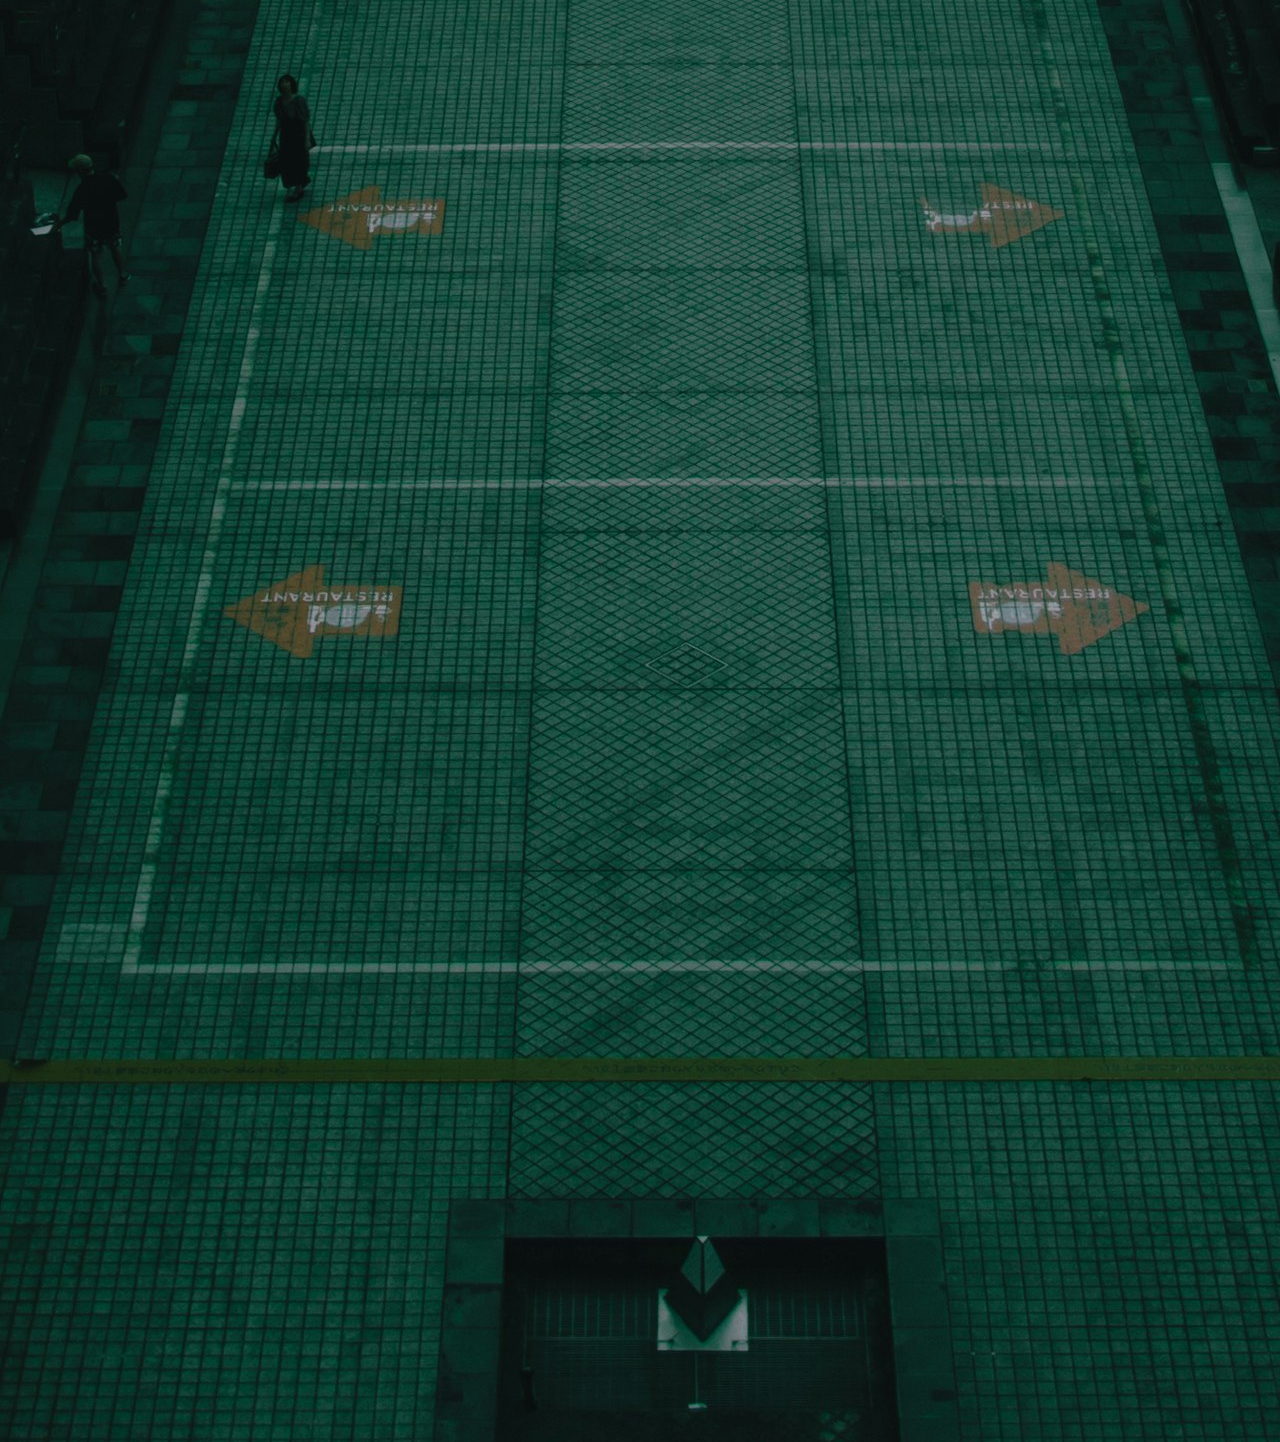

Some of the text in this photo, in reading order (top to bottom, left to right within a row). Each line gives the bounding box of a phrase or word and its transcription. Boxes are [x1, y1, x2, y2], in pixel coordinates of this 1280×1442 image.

[327, 202, 439, 212] RESTAURANT
[260, 591, 394, 602] RESTAURANT
[977, 588, 1112, 599] RESTAURANT
